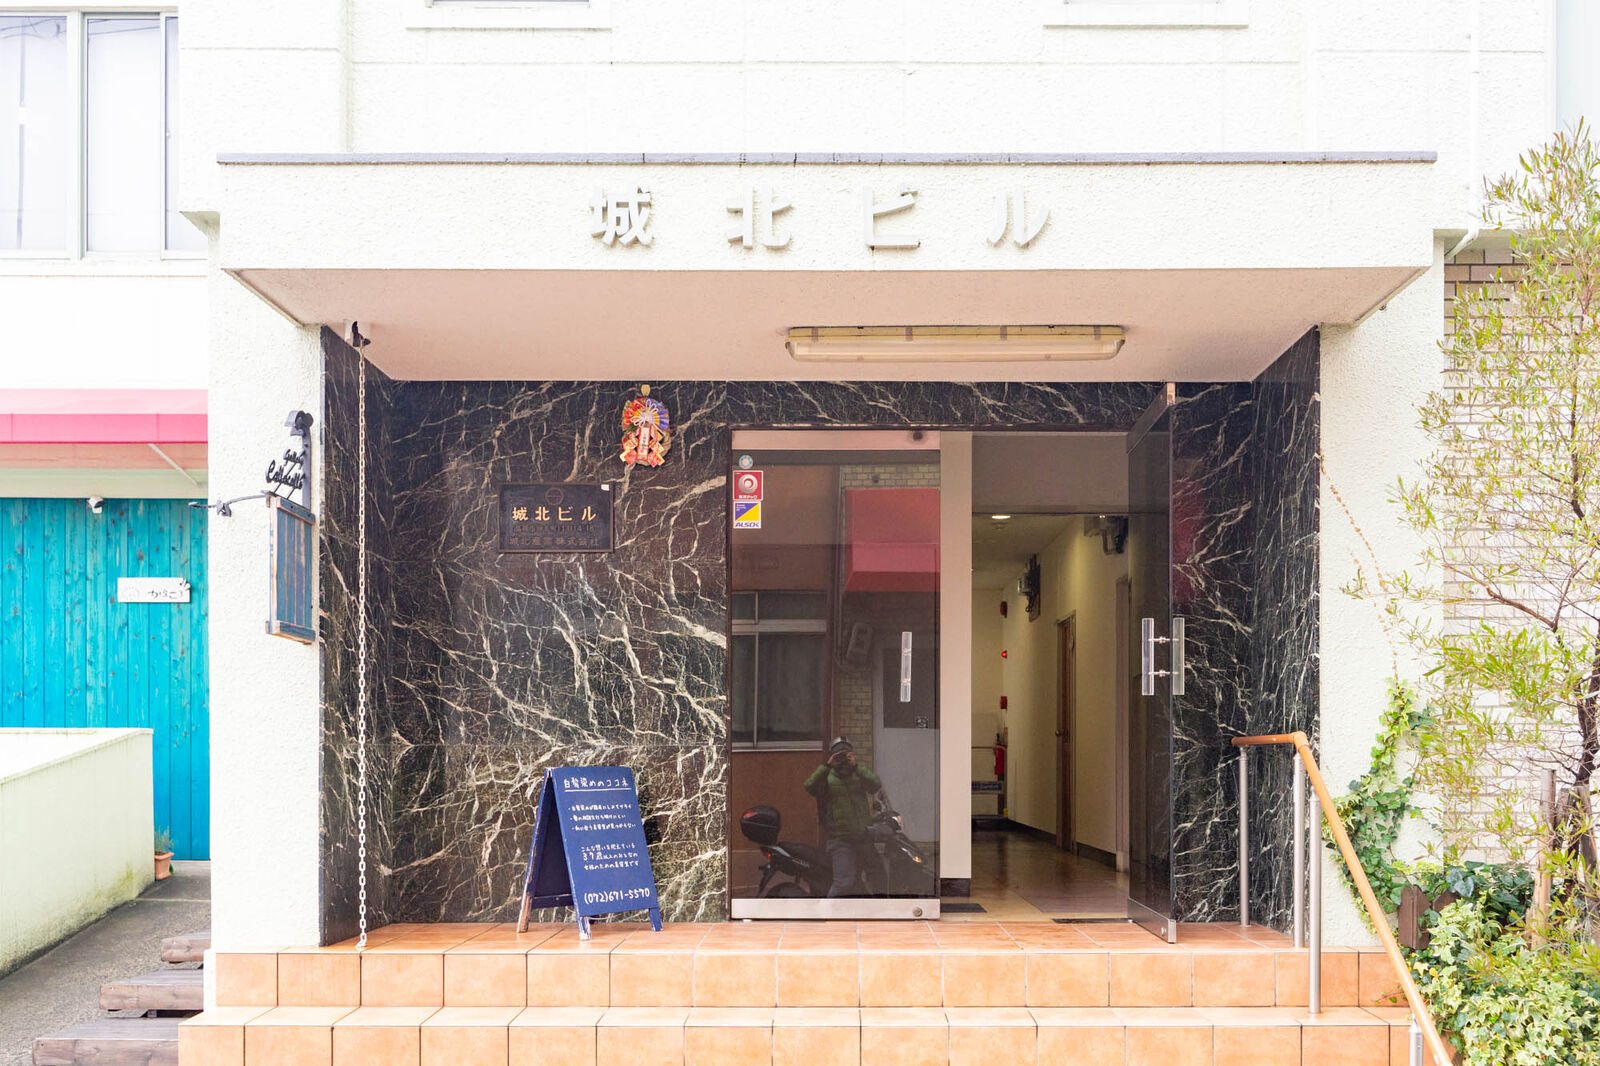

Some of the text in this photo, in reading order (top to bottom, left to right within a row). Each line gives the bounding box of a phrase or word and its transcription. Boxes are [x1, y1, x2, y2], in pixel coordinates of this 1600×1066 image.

[591, 186, 1050, 248] 城北ビル
[512, 505, 597, 522] 城北ビル
[563, 776, 629, 789] 白髪染めのココネ
[584, 887, 650, 905] (072)671-5570
